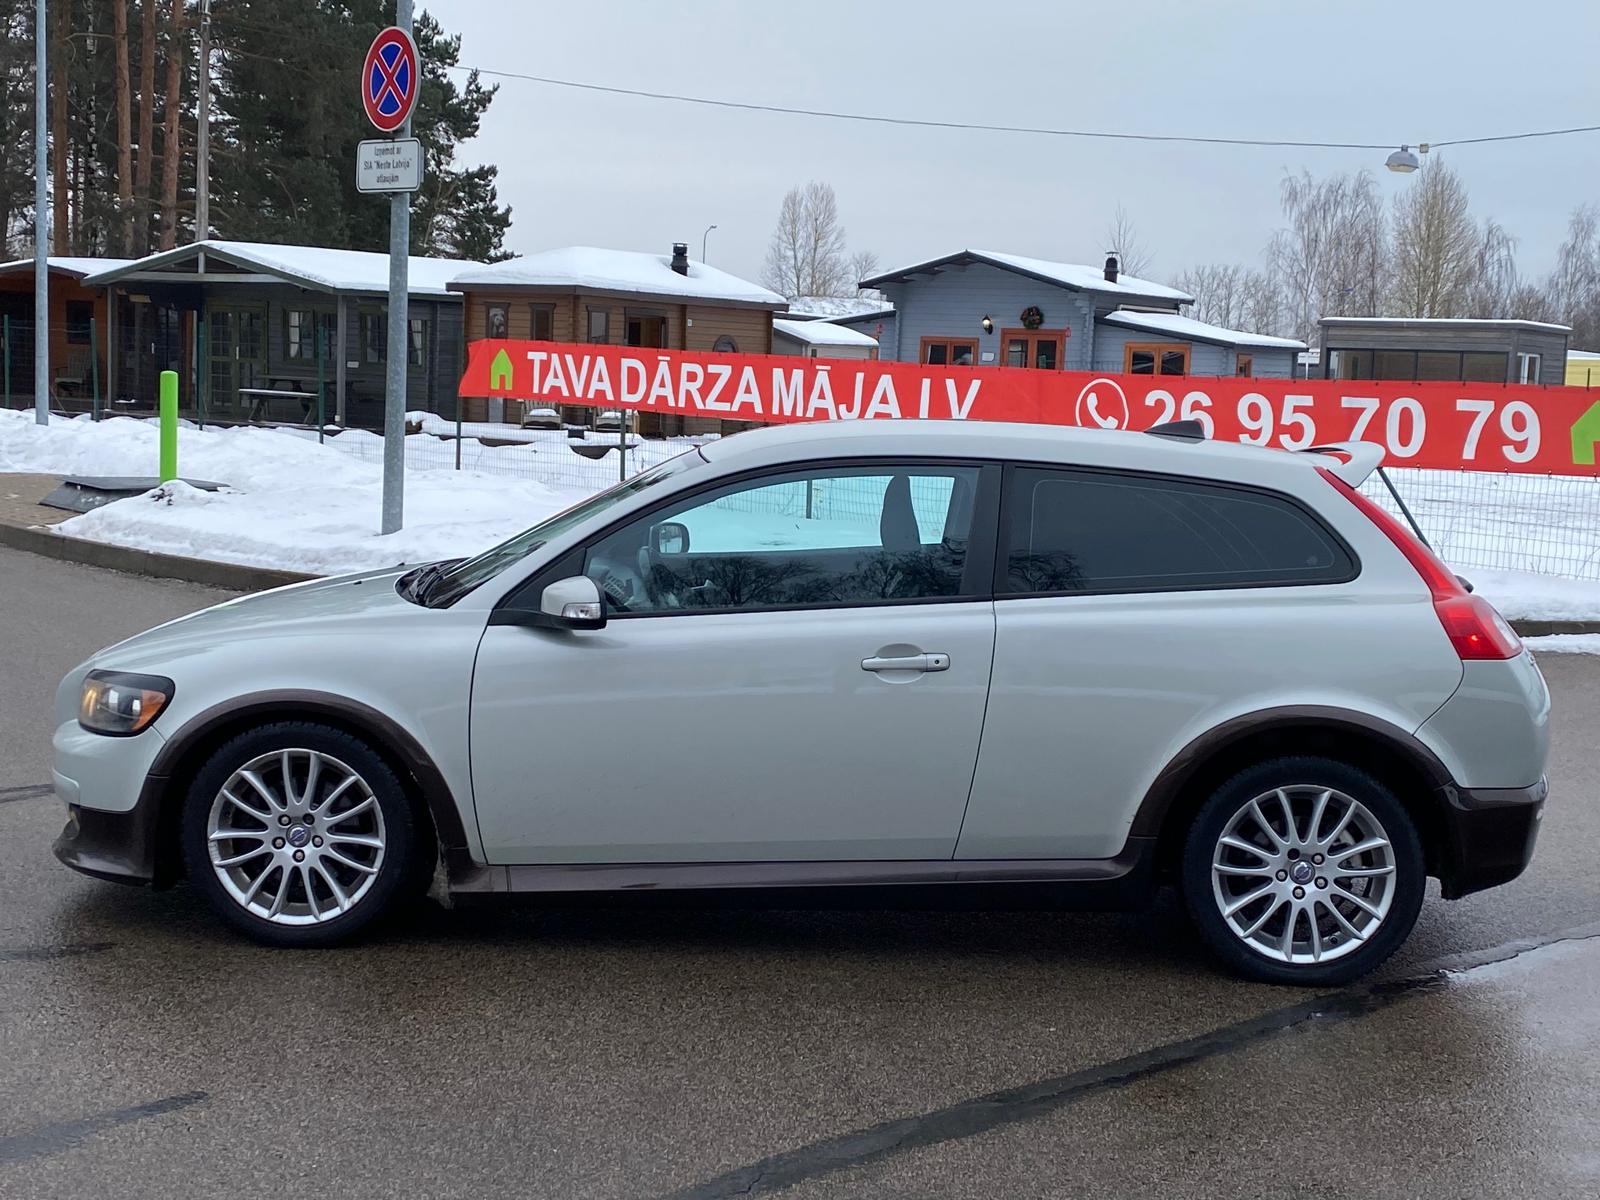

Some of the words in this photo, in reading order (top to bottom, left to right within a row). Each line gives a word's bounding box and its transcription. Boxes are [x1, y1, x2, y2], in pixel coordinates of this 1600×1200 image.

[363, 160, 373, 170] SIA
[527, 351, 614, 401] TAVA
[620, 356, 764, 414] DĀRZA
[1144, 389, 1215, 440] 26
[1237, 392, 1317, 452] 95
[1341, 396, 1427, 459] 70
[1456, 399, 1542, 463] 79
